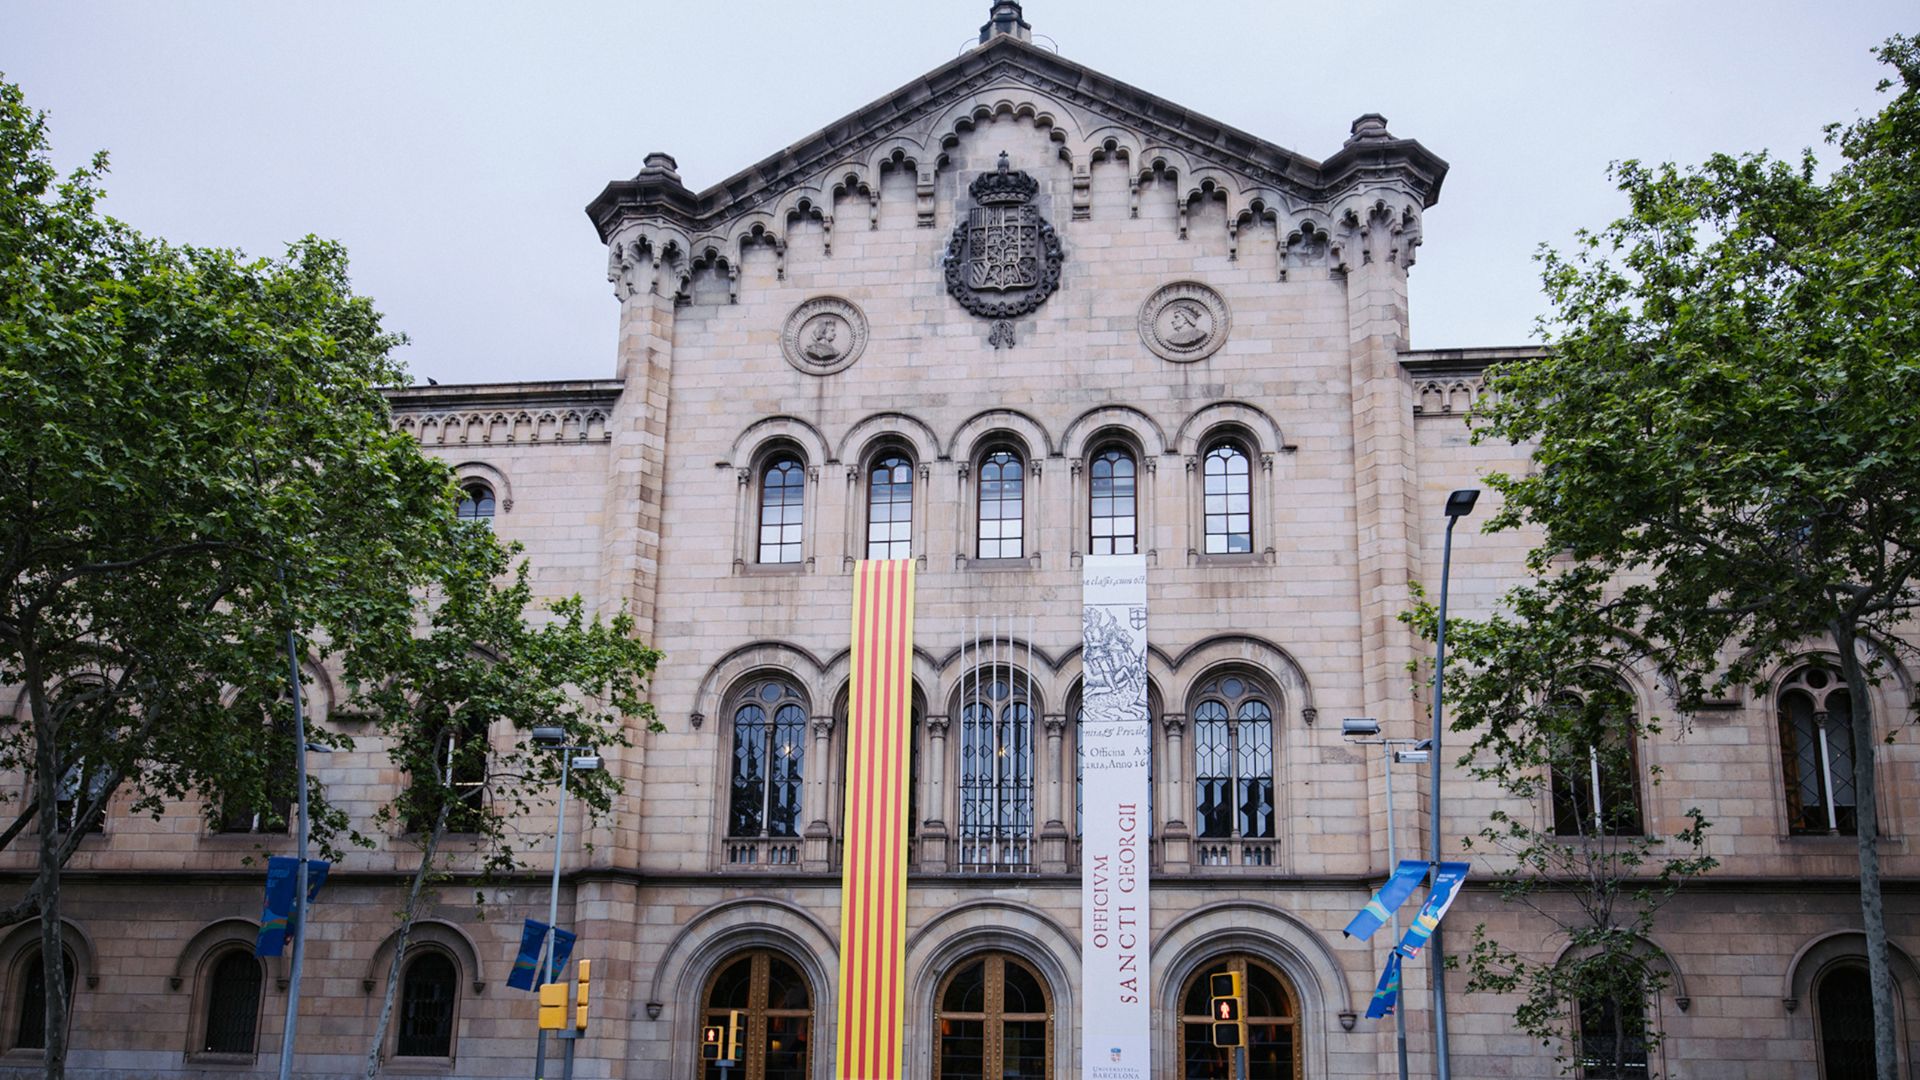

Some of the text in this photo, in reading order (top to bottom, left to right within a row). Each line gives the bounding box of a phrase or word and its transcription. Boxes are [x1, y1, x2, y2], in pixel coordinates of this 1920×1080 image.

[1090, 746, 1126, 757] Officina
[1093, 855, 1109, 949] OFFICIVM
[1118, 803, 1138, 1004] SANCTI GEORGII
[1092, 1072, 1140, 1080] BARCELONA
